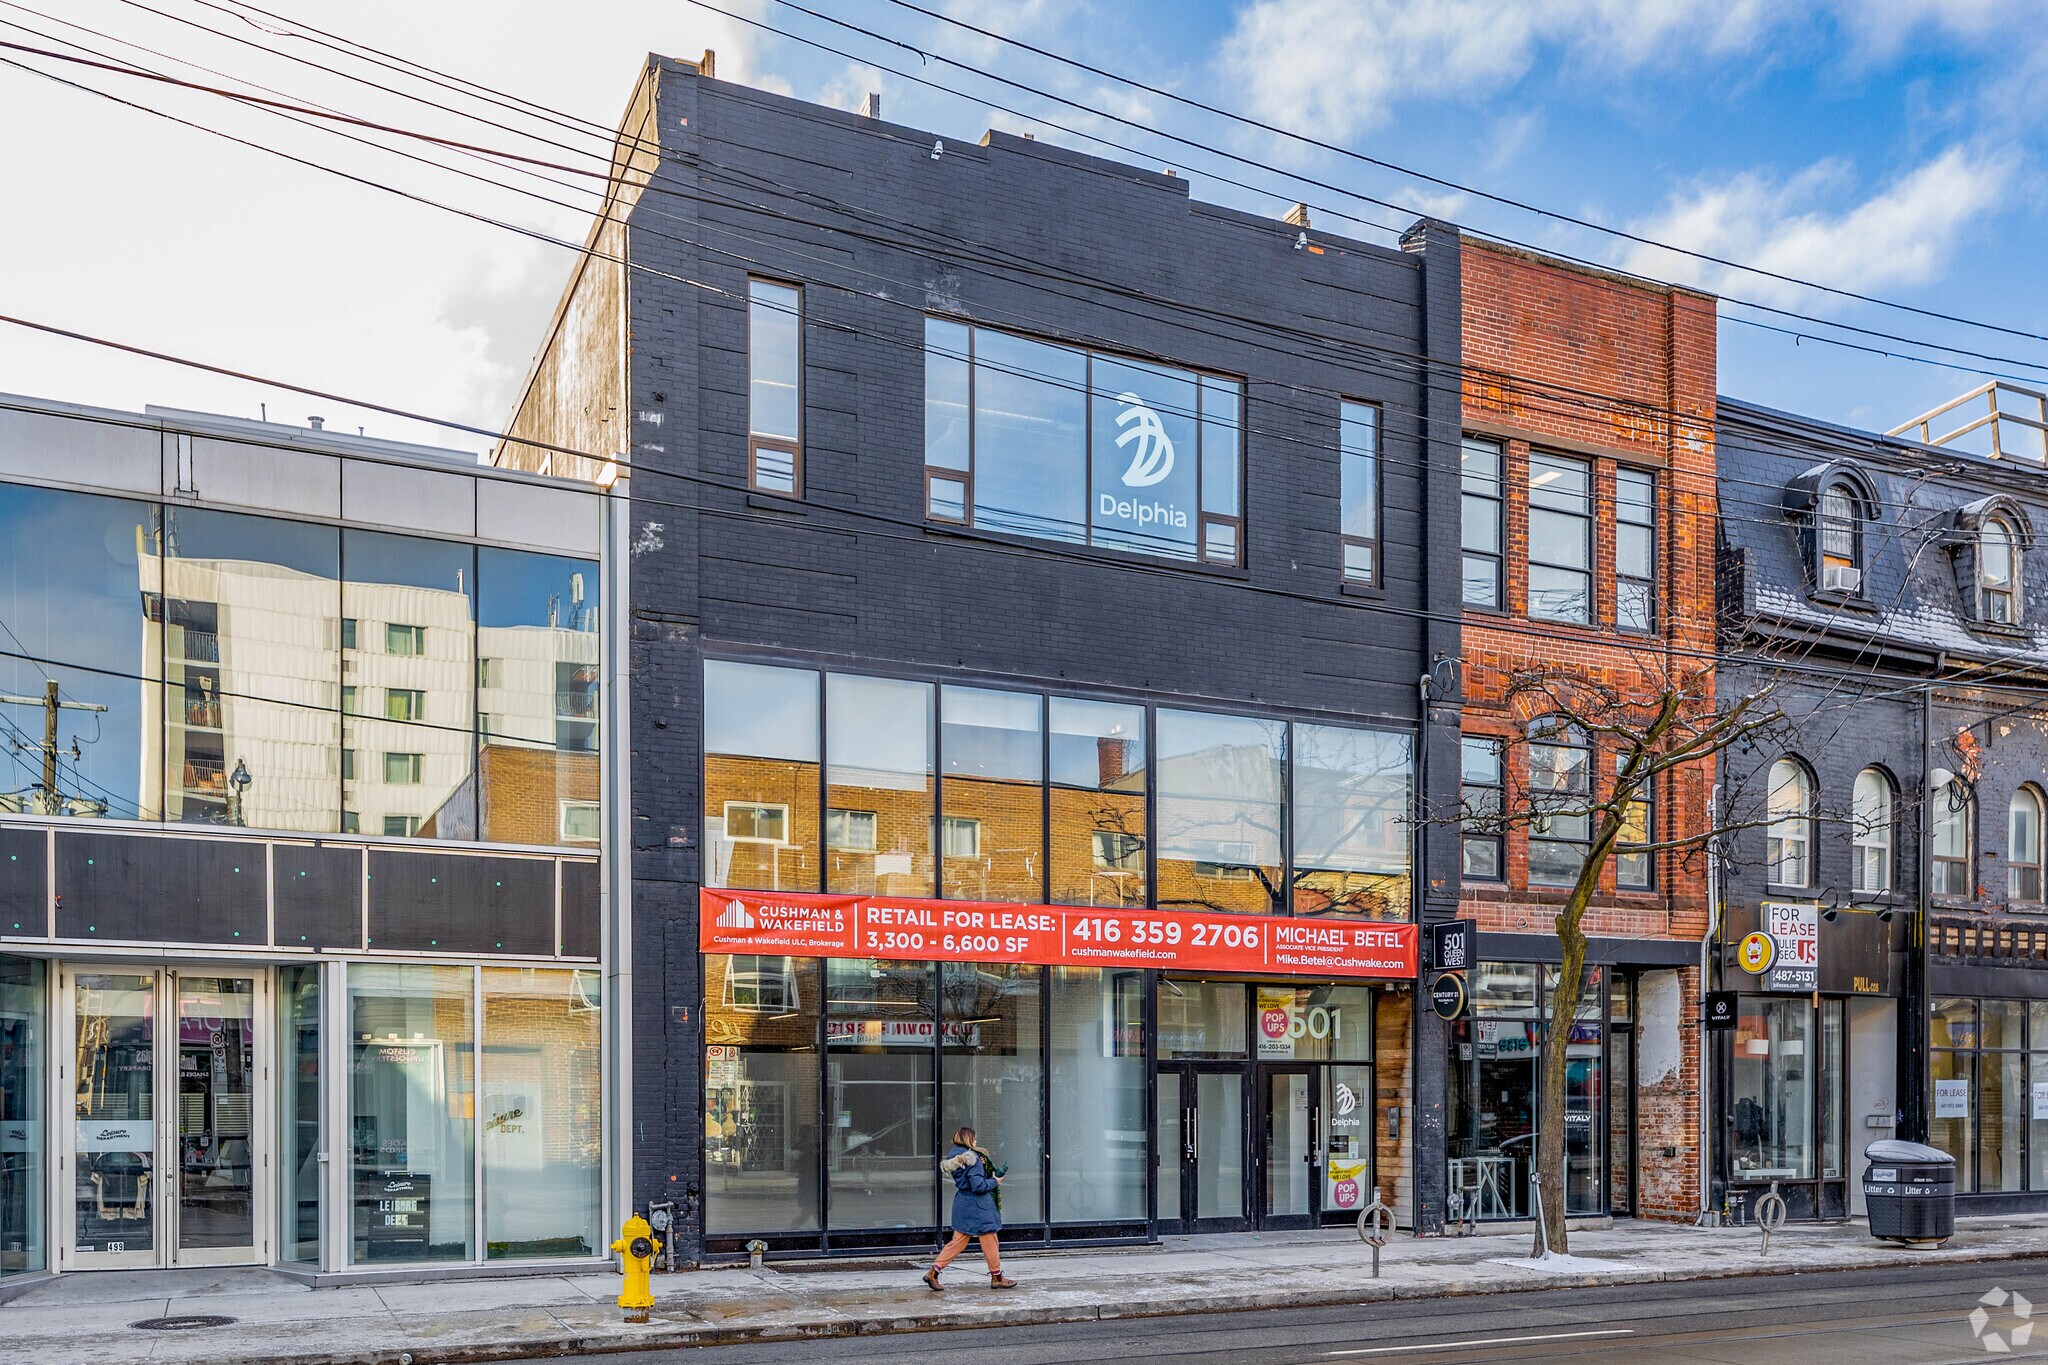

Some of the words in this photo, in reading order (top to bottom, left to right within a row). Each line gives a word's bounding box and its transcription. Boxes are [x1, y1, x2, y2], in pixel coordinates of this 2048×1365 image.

[1100, 493, 1187, 528] Delphia
[759, 906, 831, 919] CUSHMAN
[835, 909, 844, 920] &
[1772, 907, 1800, 921] FOR
[866, 907, 937, 926] RETAIL
[943, 911, 984, 928] FOR
[990, 913, 1056, 931] LEASE:
[759, 919, 844, 932] WAKEFIELD
[1772, 922, 1816, 936] LEASE
[1072, 918, 1121, 942] 416
[1131, 920, 1182, 945] 359
[1191, 923, 1259, 948] 2706
[1275, 926, 1349, 946] MICHAEL
[1354, 930, 1404, 948] BETEL
[713, 935, 746, 944] Cushman
[747, 936, 753, 944] &
[754, 937, 790, 946] Wakefield
[791, 939, 807, 947] ULC,
[809, 940, 844, 948] Brokerage
[866, 931, 924, 950] 3,300
[943, 935, 1000, 953] 6,600
[1005, 936, 1029, 953] SF
[1443, 933, 1465, 950] 501
[1071, 947, 1177, 959] cushmanwakefield.com
[1443, 948, 1465, 959] QUEEN
[1779, 950, 1797, 960] SEO
[1276, 954, 1404, 969] Mike.Betel@Cushwake.com
[1444, 957, 1465, 967] WEST
[1775, 970, 1815, 981] 487-5131
[1265, 1013, 1285, 1023] POP
[1288, 1006, 1341, 1040] 501
[1267, 1022, 1285, 1032] UPS
[1936, 1089, 1948, 1097] FOR
[1949, 1089, 1967, 1097] LEASE
[1331, 1118, 1360, 1127] Delphia
[100, 1129, 127, 1137] Leisure
[500, 1124, 525, 1134] DEPT.
[1338, 1183, 1355, 1193] POP
[1864, 1184, 1883, 1193] Litter
[1905, 1186, 1923, 1195] Litter
[1339, 1193, 1356, 1203] UPS
[108, 1242, 124, 1251] 499
